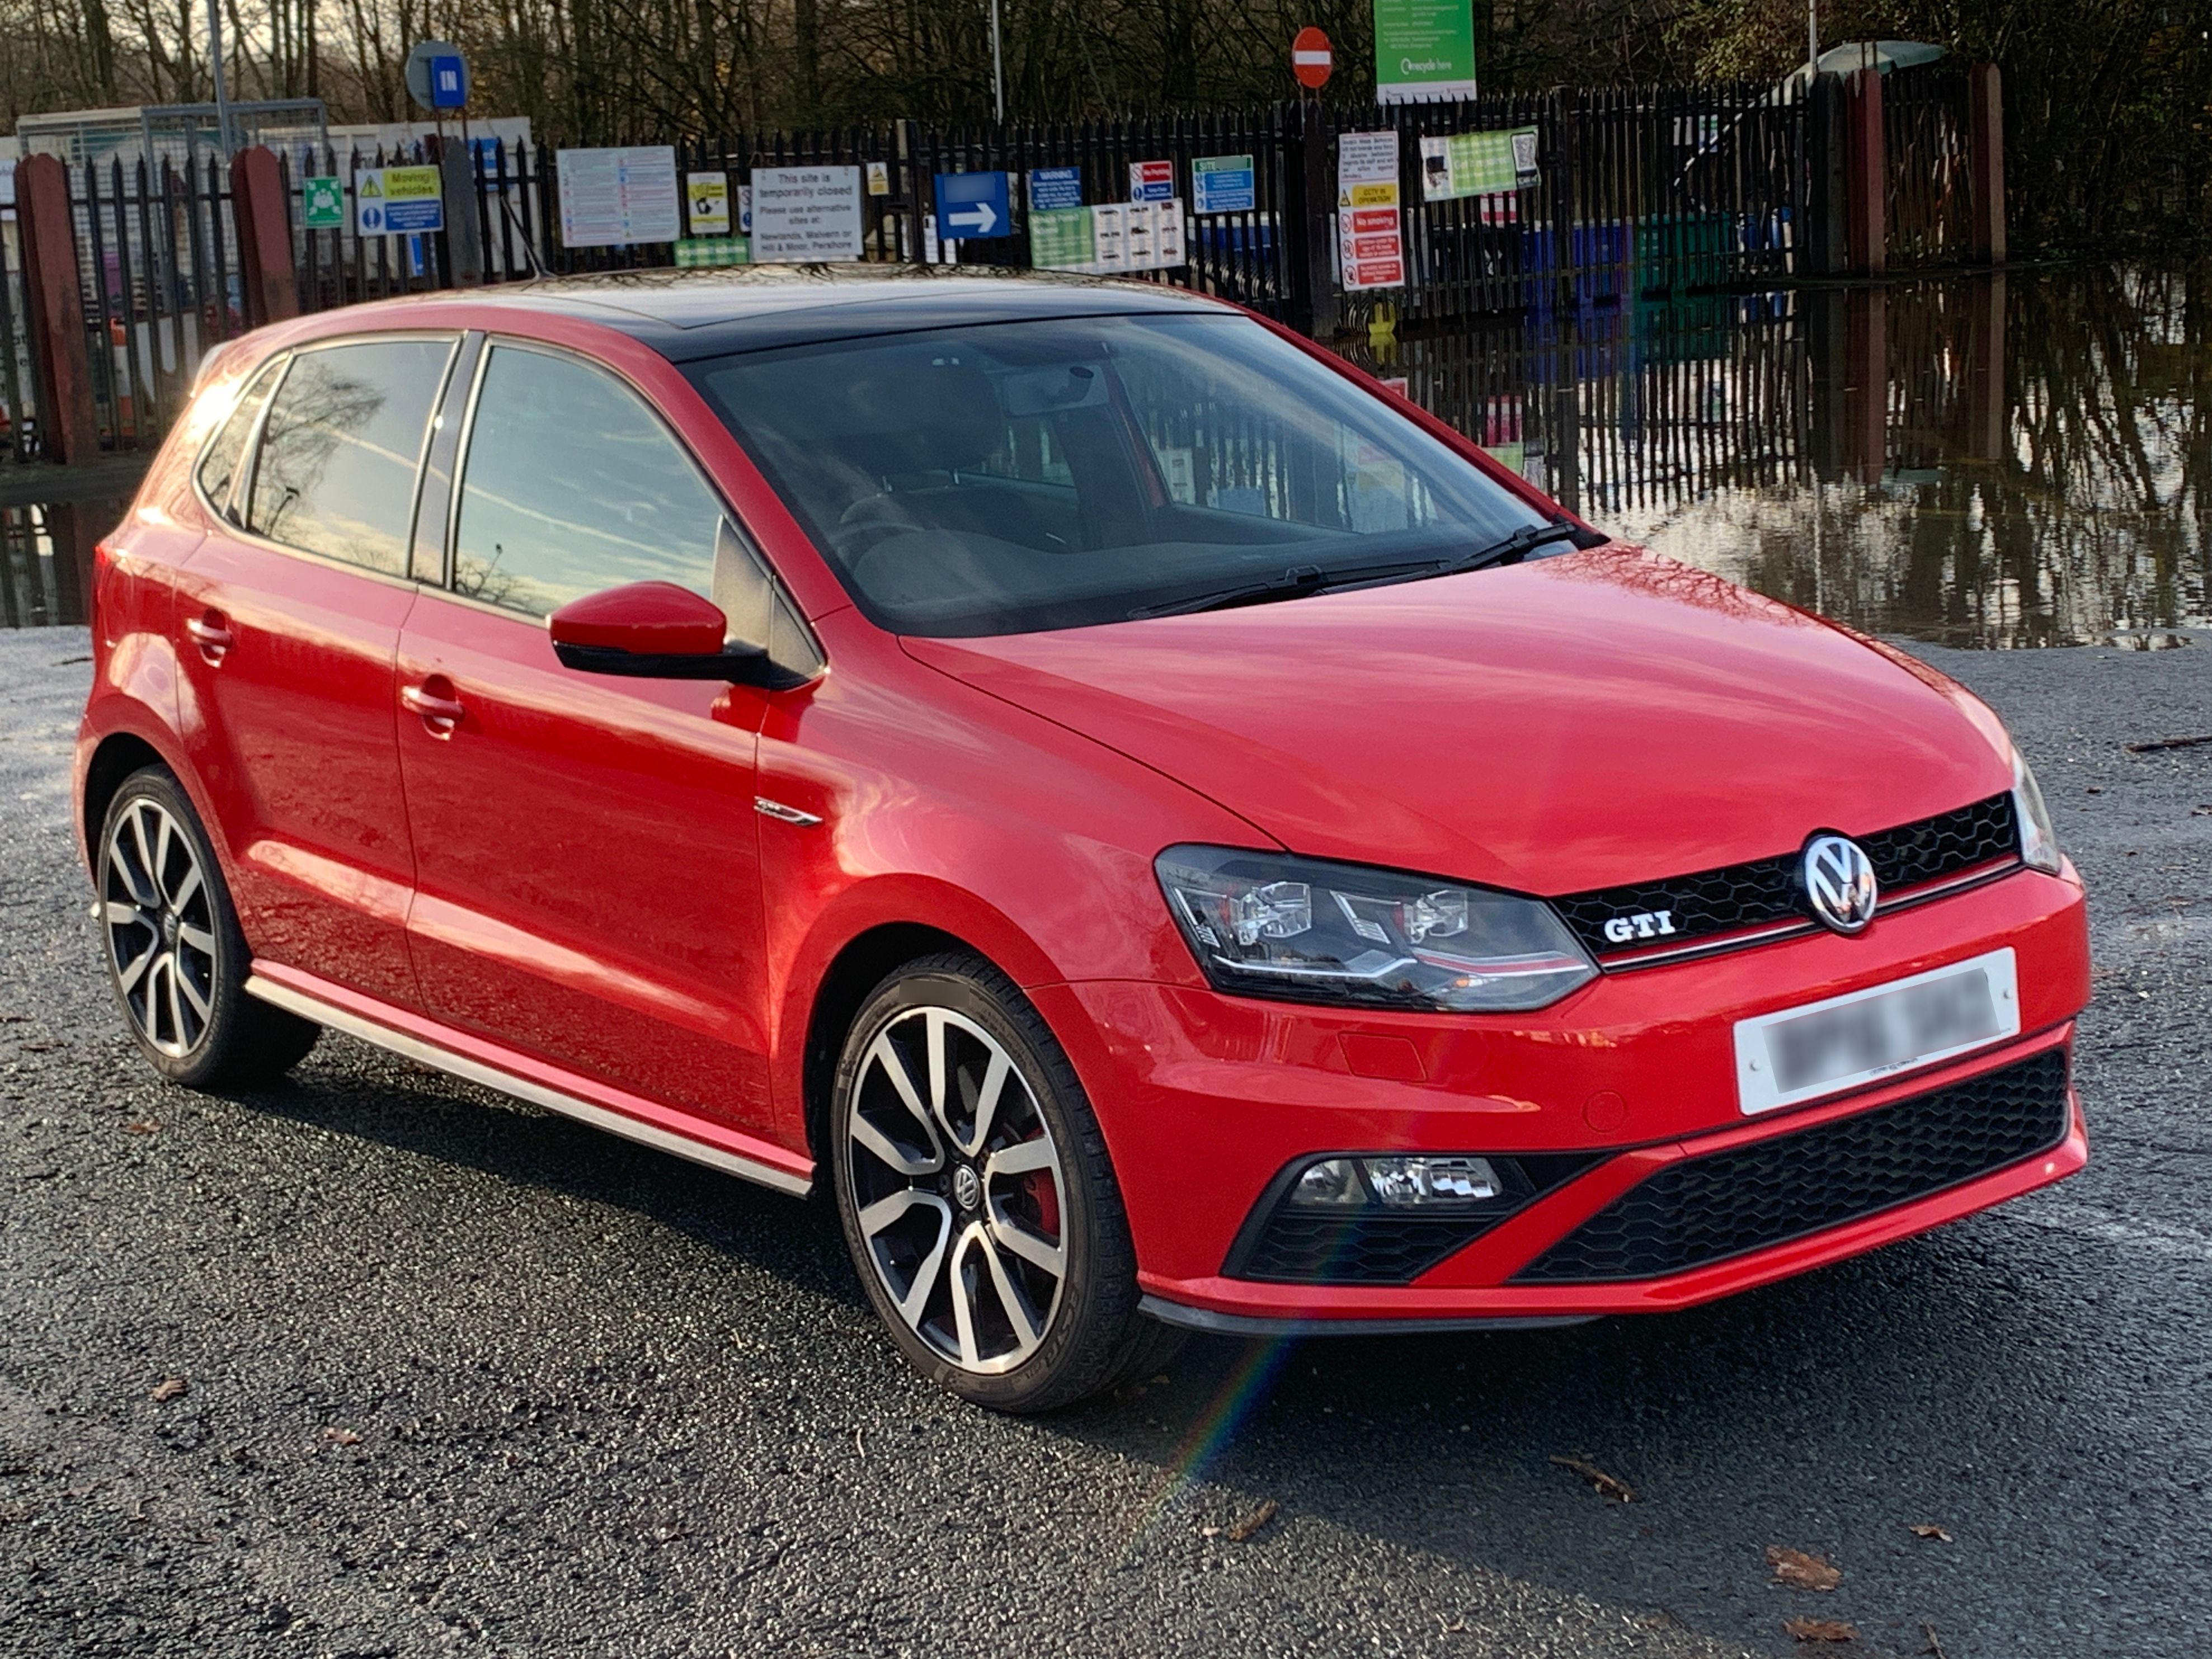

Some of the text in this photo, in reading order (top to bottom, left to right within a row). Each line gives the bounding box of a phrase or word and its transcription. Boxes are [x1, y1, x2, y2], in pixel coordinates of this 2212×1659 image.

[392, 172, 430, 184] Moving
[778, 173, 831, 183] This site is
[390, 185, 434, 196] vehicles
[759, 185, 852, 199] temporarily closed
[760, 205, 786, 214] Please
[807, 204, 851, 213] alternative
[1604, 910, 1676, 942] GTI
